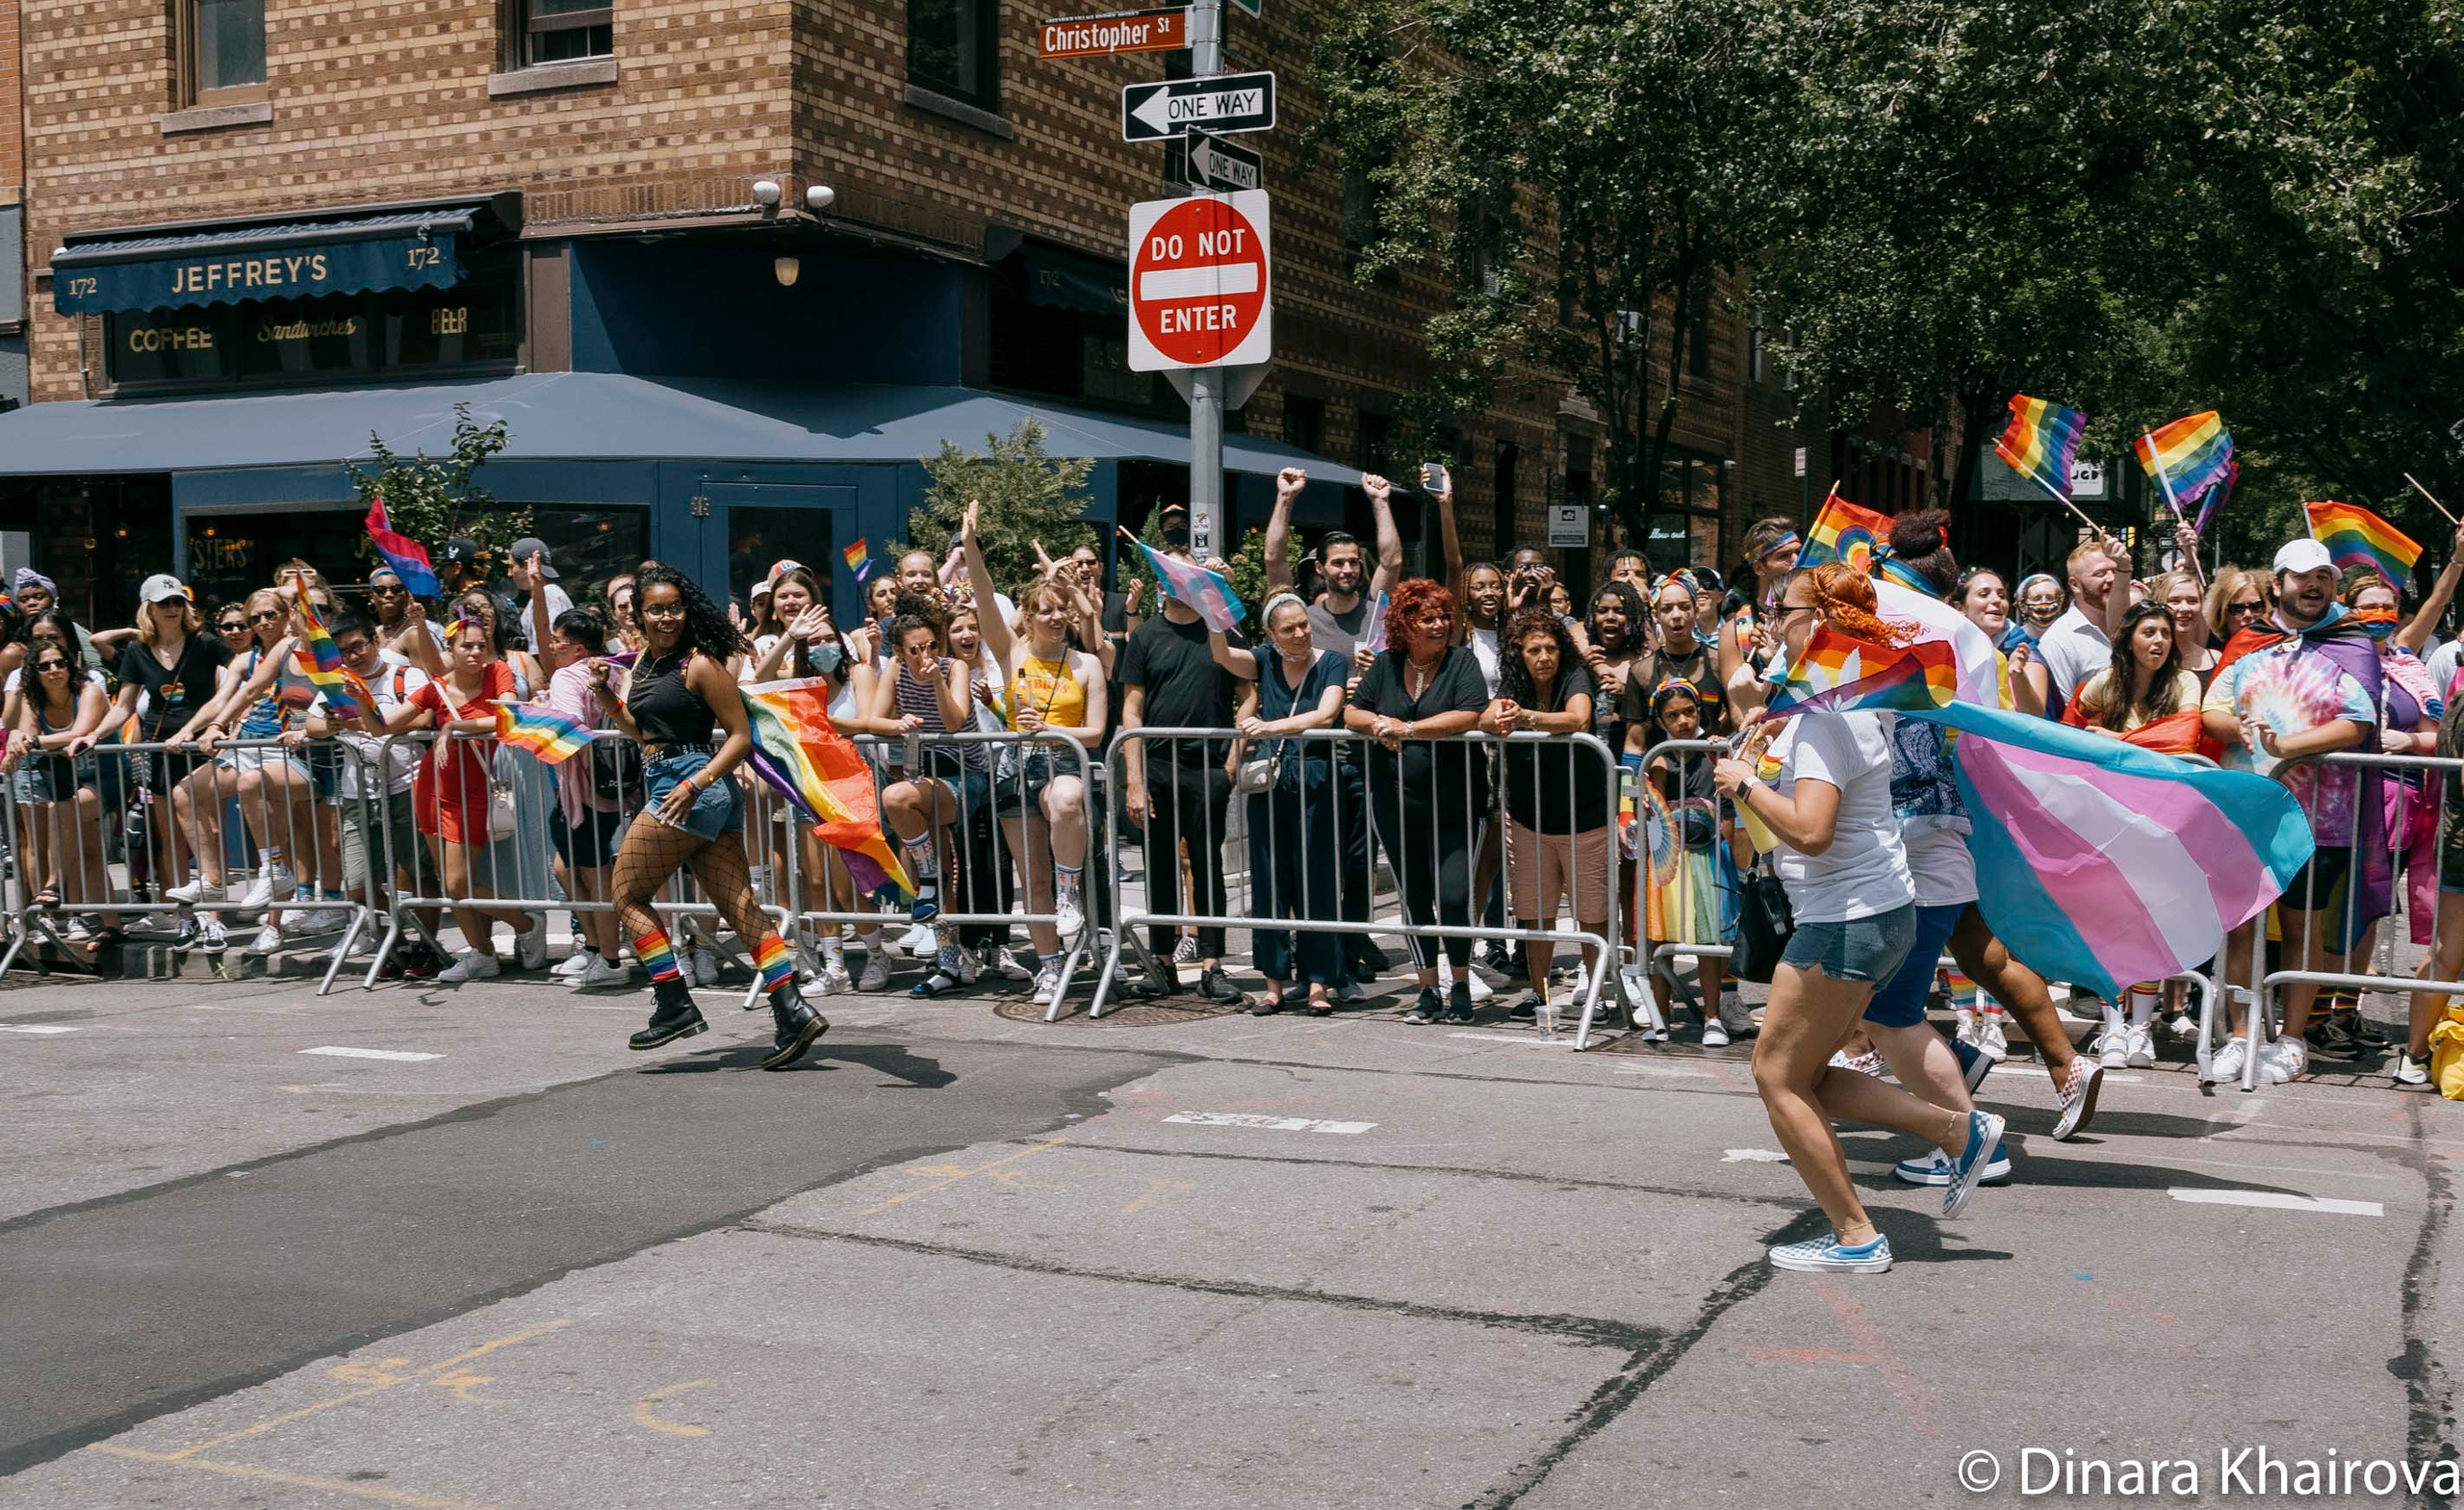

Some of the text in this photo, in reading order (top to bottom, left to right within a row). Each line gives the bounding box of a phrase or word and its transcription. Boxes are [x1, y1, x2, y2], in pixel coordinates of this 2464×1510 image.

[1045, 21, 1150, 52] Christopher
[1157, 17, 1170, 33] St
[1168, 91, 1257, 119] ONE WAY
[1209, 153, 1254, 188] ONE WAY
[407, 247, 440, 270] 172
[1151, 228, 1245, 262] DO NOT
[171, 254, 327, 294] JEFFREY'S
[68, 277, 96, 301] 172
[257, 314, 357, 343] Sandwiches
[432, 307, 468, 335] BEER
[1160, 304, 1237, 333] ENTER
[129, 327, 214, 353] COFFEE
